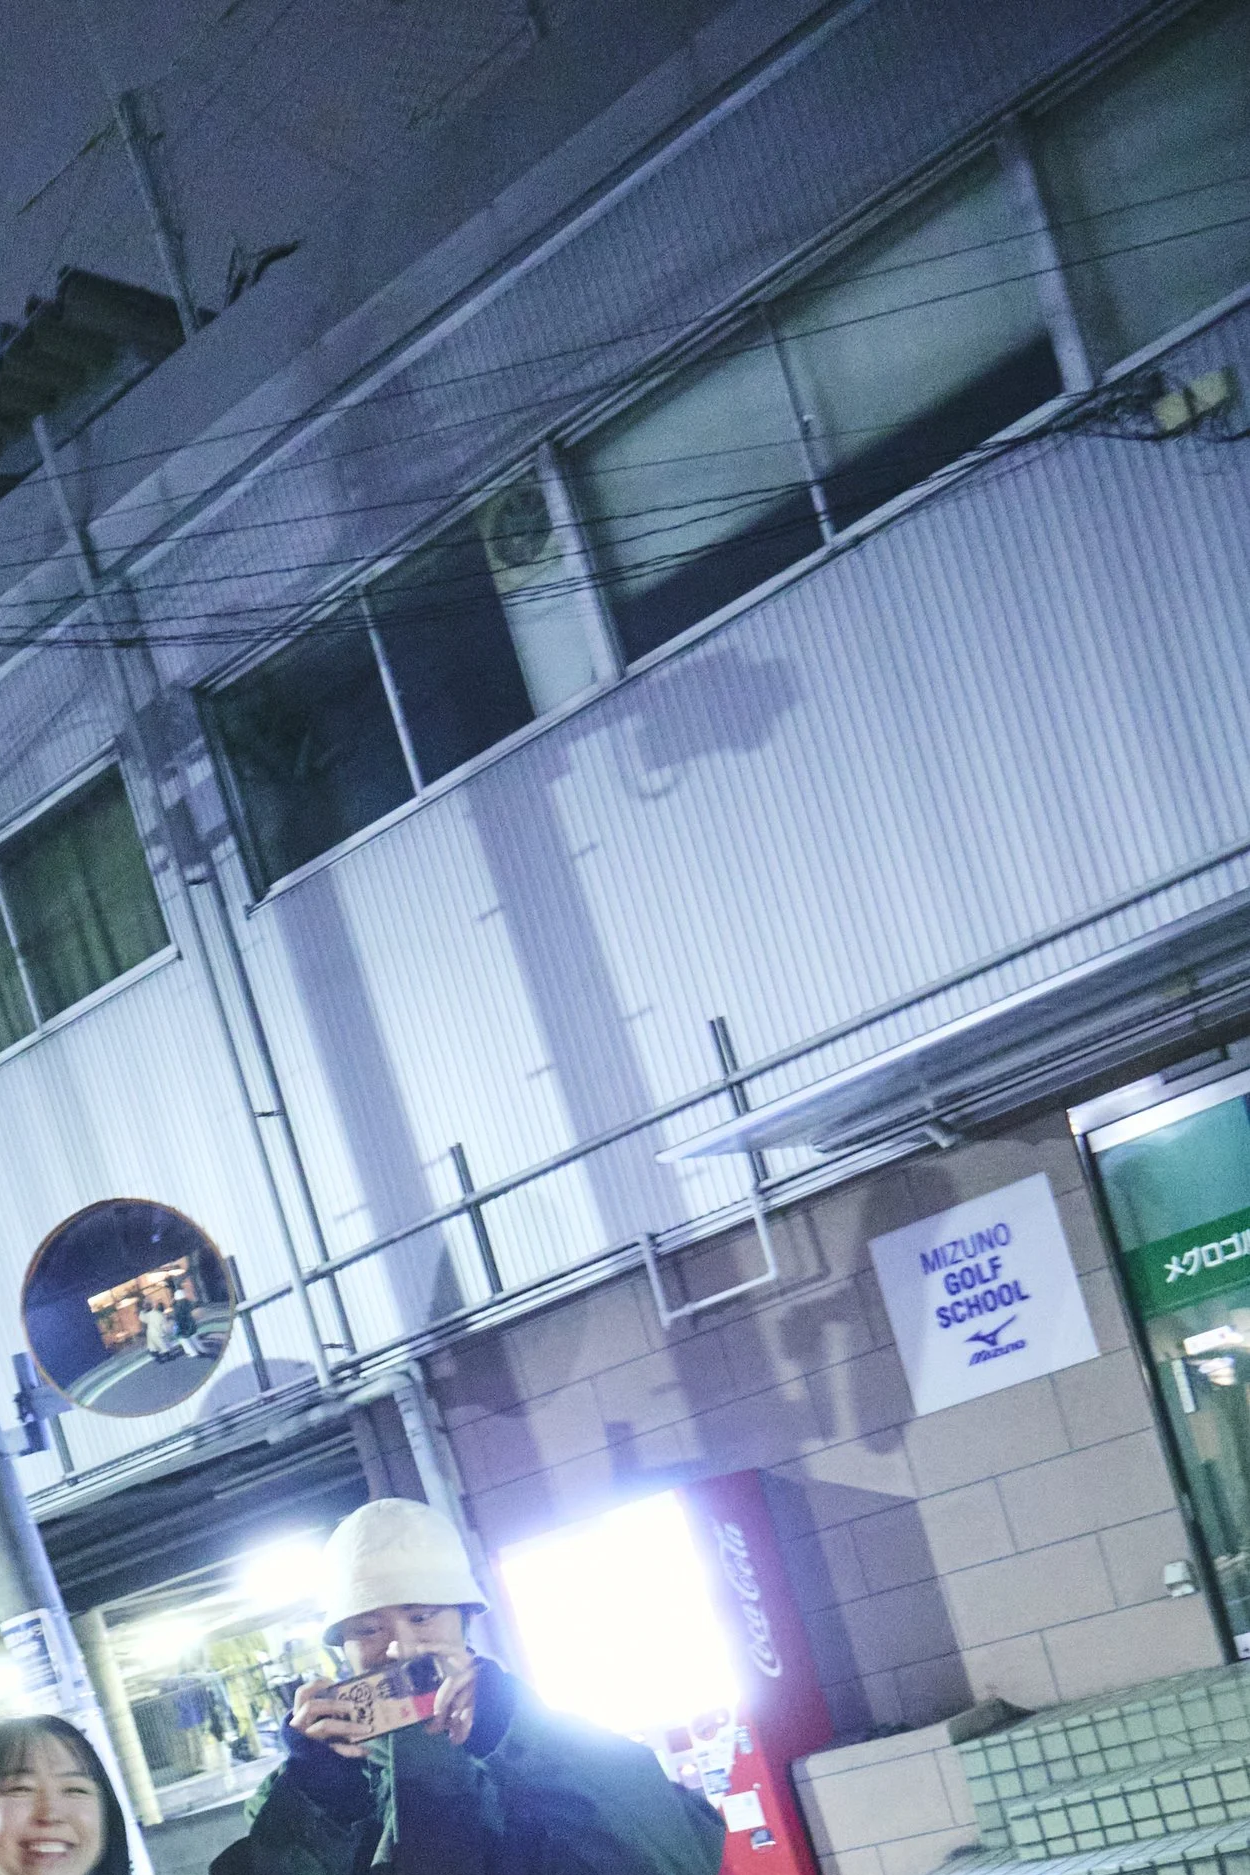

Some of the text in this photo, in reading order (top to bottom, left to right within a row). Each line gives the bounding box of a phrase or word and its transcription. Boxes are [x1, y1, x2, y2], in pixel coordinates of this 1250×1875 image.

[919, 1222, 1012, 1276] MIZUNO
[943, 1255, 1002, 1296] GOLF
[935, 1279, 1031, 1329] SCHOOL
